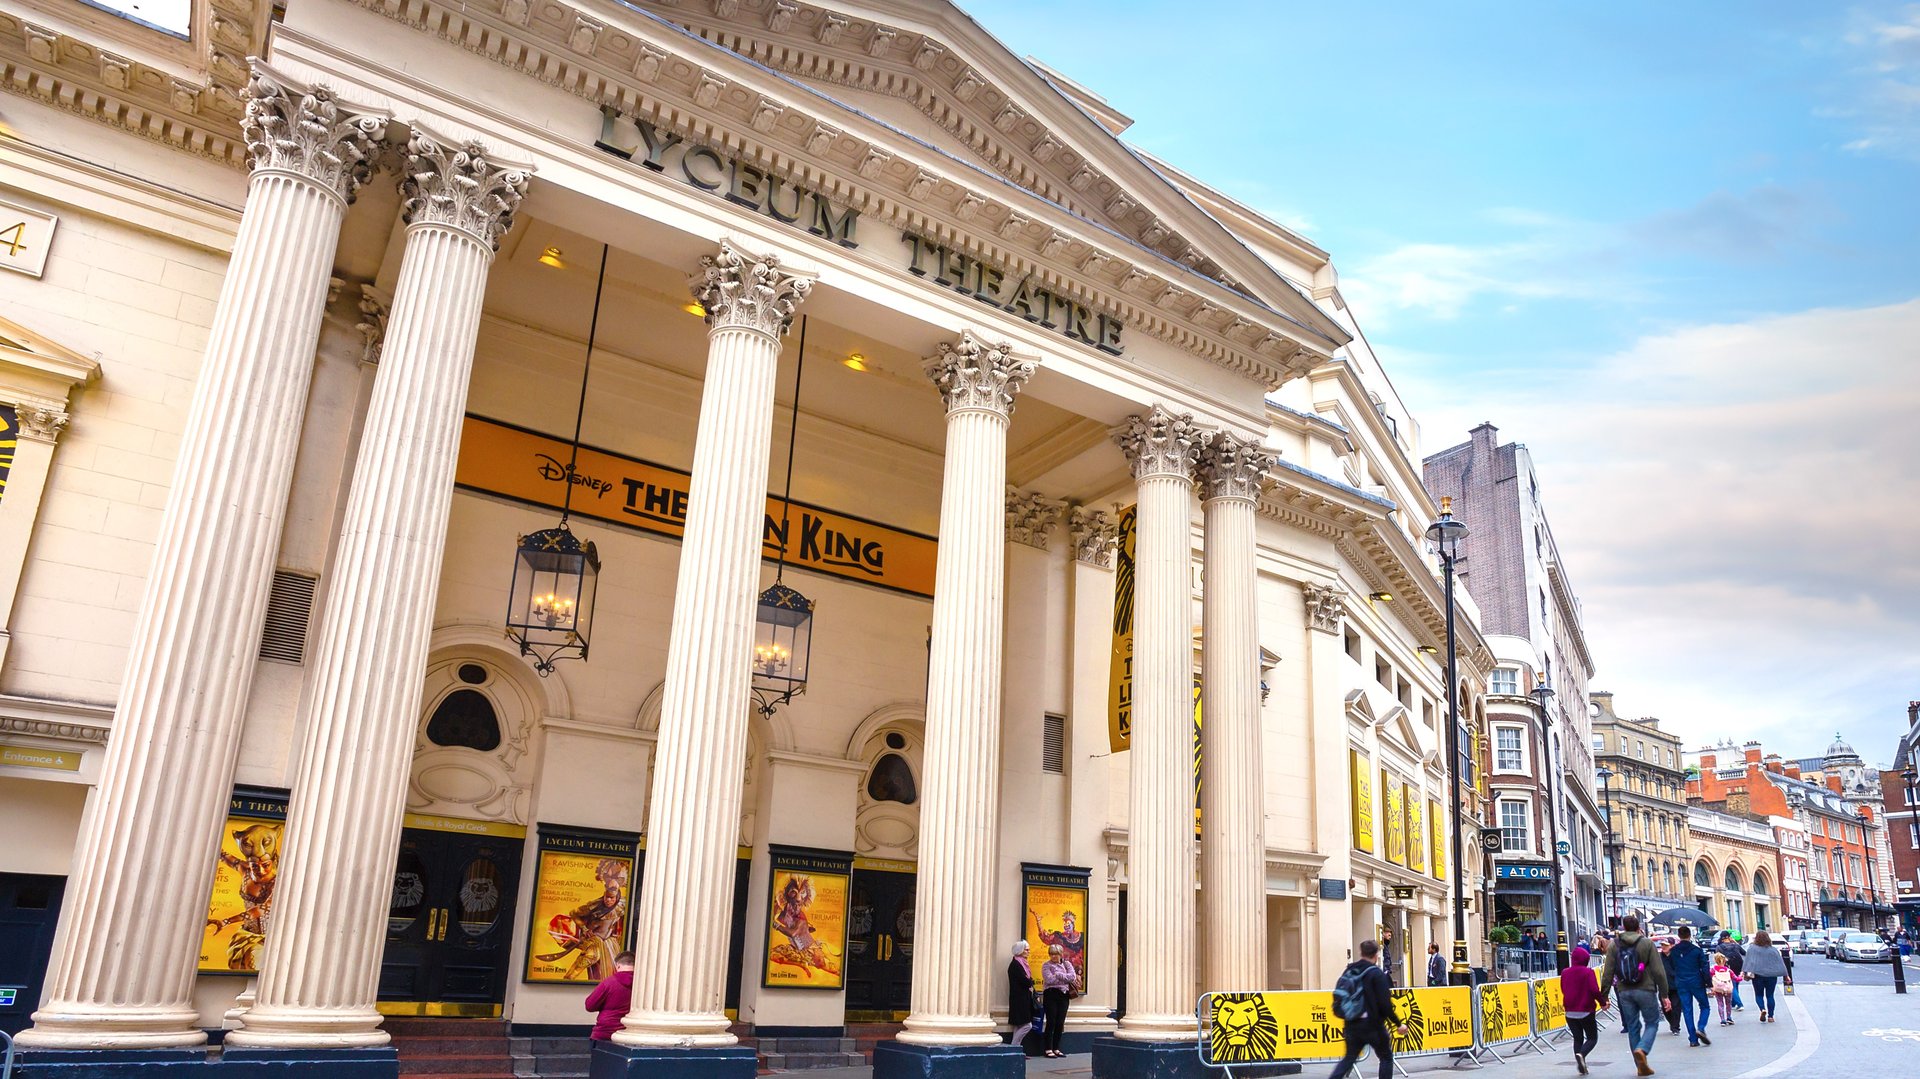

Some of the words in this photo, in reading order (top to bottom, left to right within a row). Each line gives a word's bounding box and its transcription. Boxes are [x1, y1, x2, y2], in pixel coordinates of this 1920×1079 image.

[594, 105, 860, 250] LYCEUM
[902, 231, 1126, 355] THEATRE
[622, 477, 689, 524] THE
[798, 512, 883, 573] KING
[4, 751, 53, 764] Entrance
[249, 801, 288, 814] THEAT
[466, 822, 487, 832] Circle
[546, 837, 584, 848] LYCEUM
[588, 841, 631, 852] THEATRE
[552, 859, 594, 870] RAVISHING
[777, 857, 809, 866] LYCEUM
[812, 860, 845, 869] THEATRE
[1496, 867, 1502, 876] E
[1510, 867, 1526, 876] AT
[1530, 867, 1550, 877] ONE
[1028, 874, 1054, 882] LYCEUM
[1056, 876, 1085, 884] THEATRE
[1443, 1006, 1452, 1014] THE
[1311, 1012, 1327, 1021] THE
[1427, 1018, 1447, 1036] LION
[1449, 1016, 1468, 1035] KING
[1285, 1024, 1318, 1046] LION
[1322, 1022, 1345, 1044] KIN
